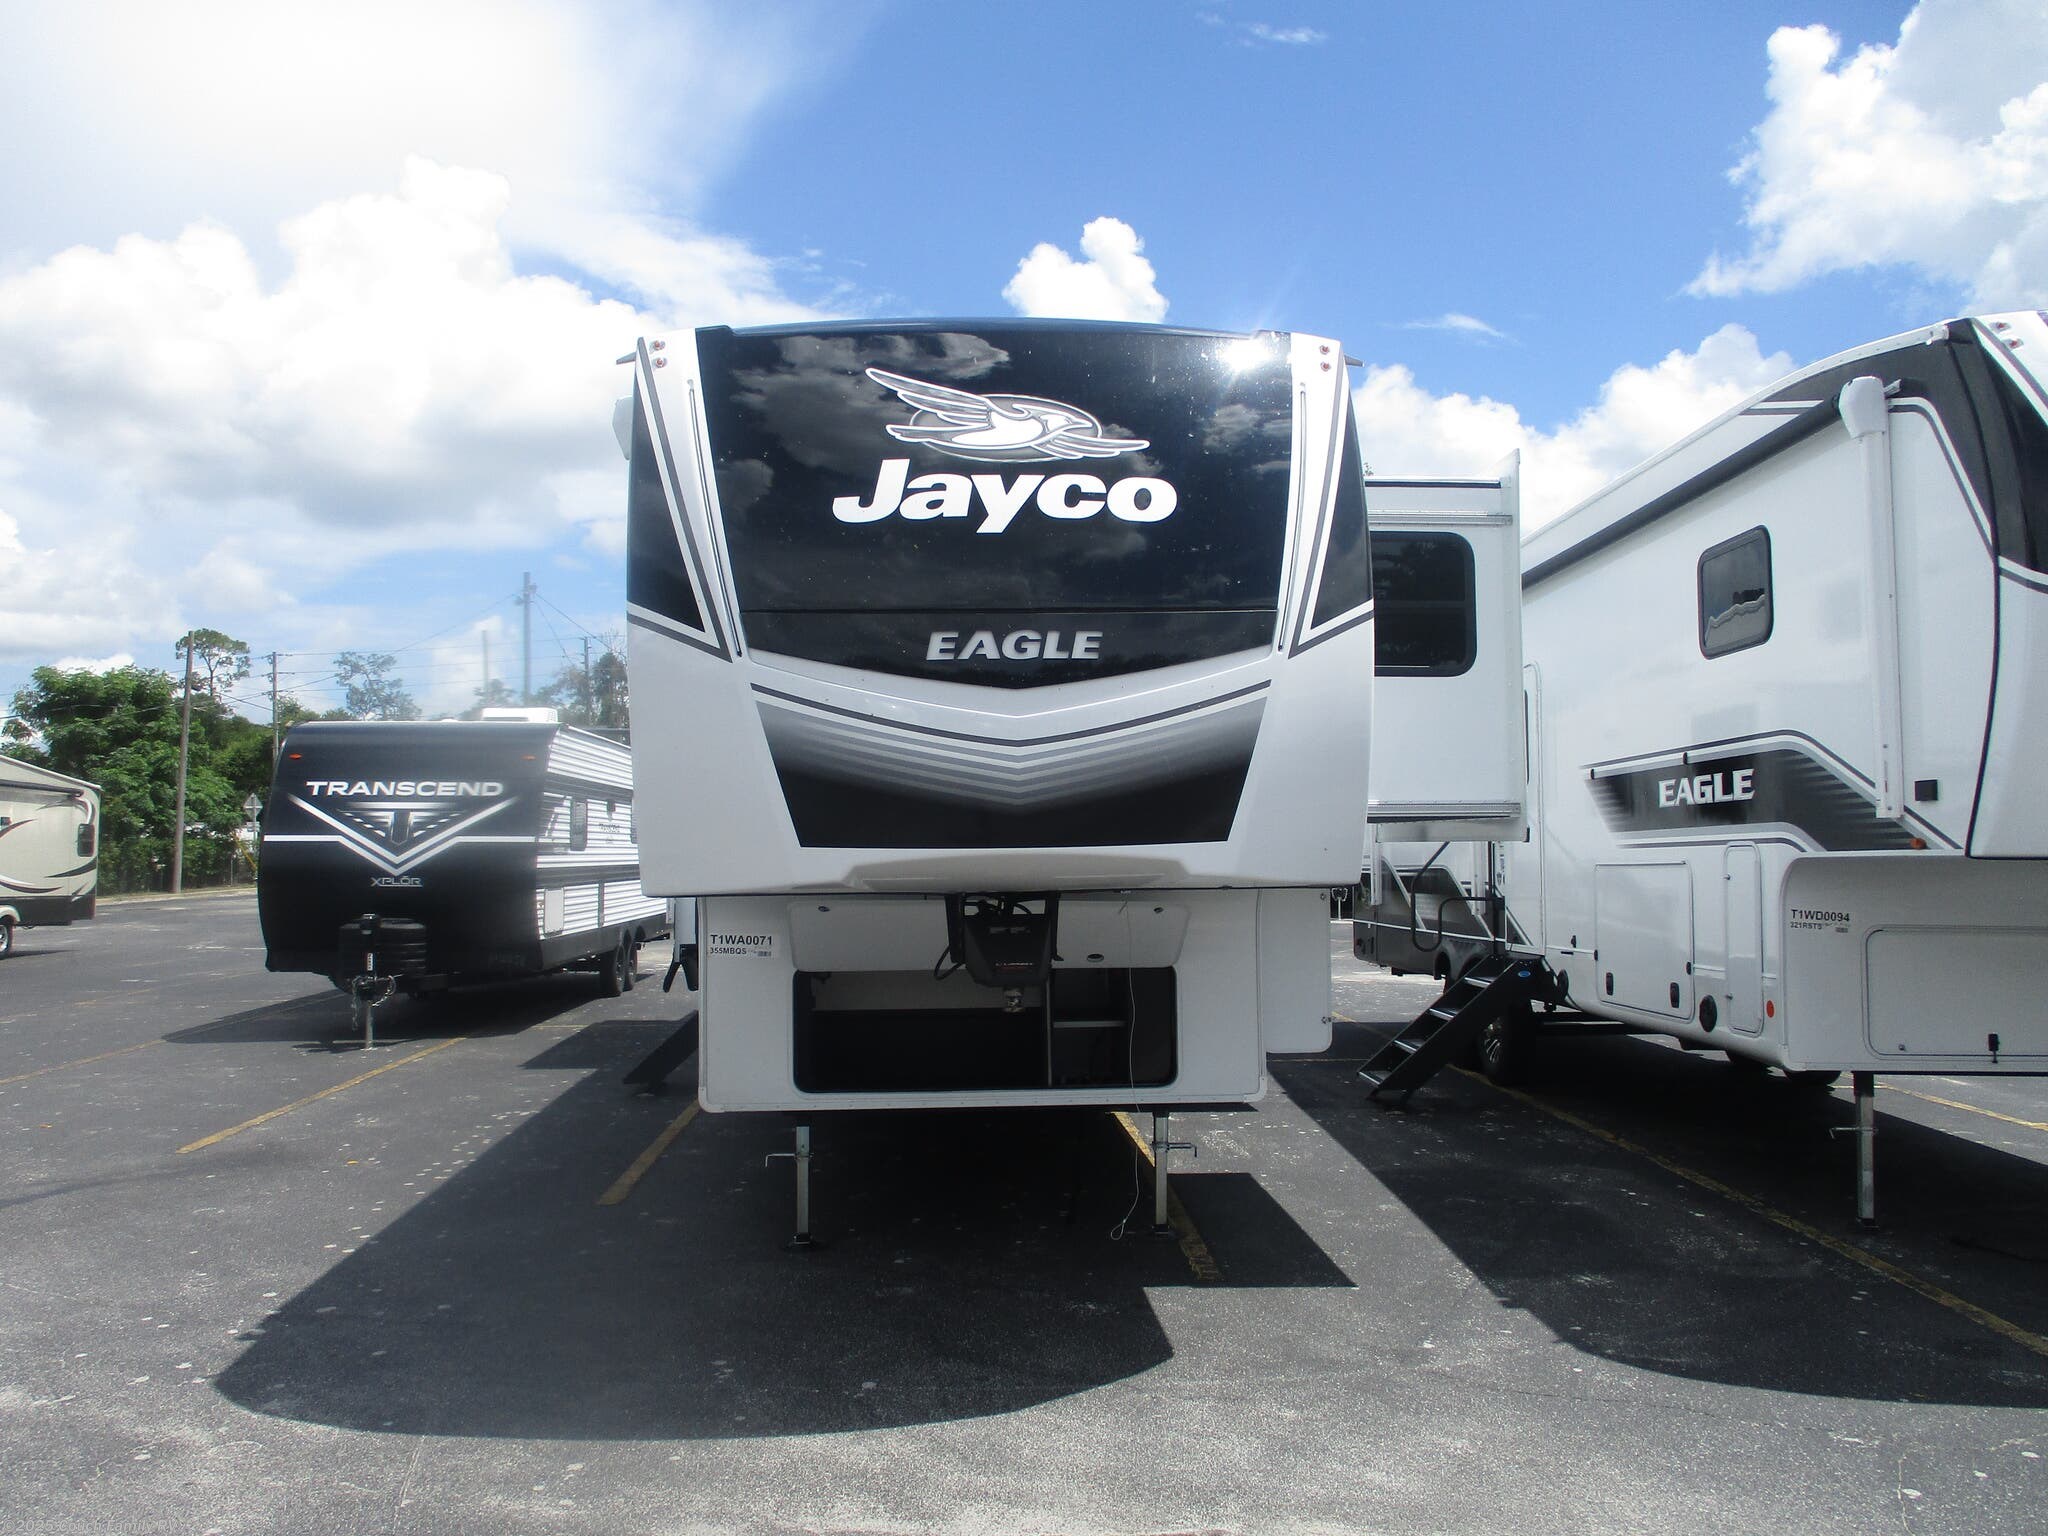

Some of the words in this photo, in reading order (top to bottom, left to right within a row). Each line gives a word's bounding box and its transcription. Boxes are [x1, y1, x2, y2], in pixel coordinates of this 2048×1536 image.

[832, 458, 1178, 534] Jayco
[926, 629, 1104, 662] EAGLE
[305, 781, 504, 796] TRANSCEND
[1658, 768, 1756, 808] EAGLE
[1791, 909, 1850, 922] T1WD0094
[710, 934, 772, 946] T1WA0071
[710, 947, 747, 955] 355MBQS
